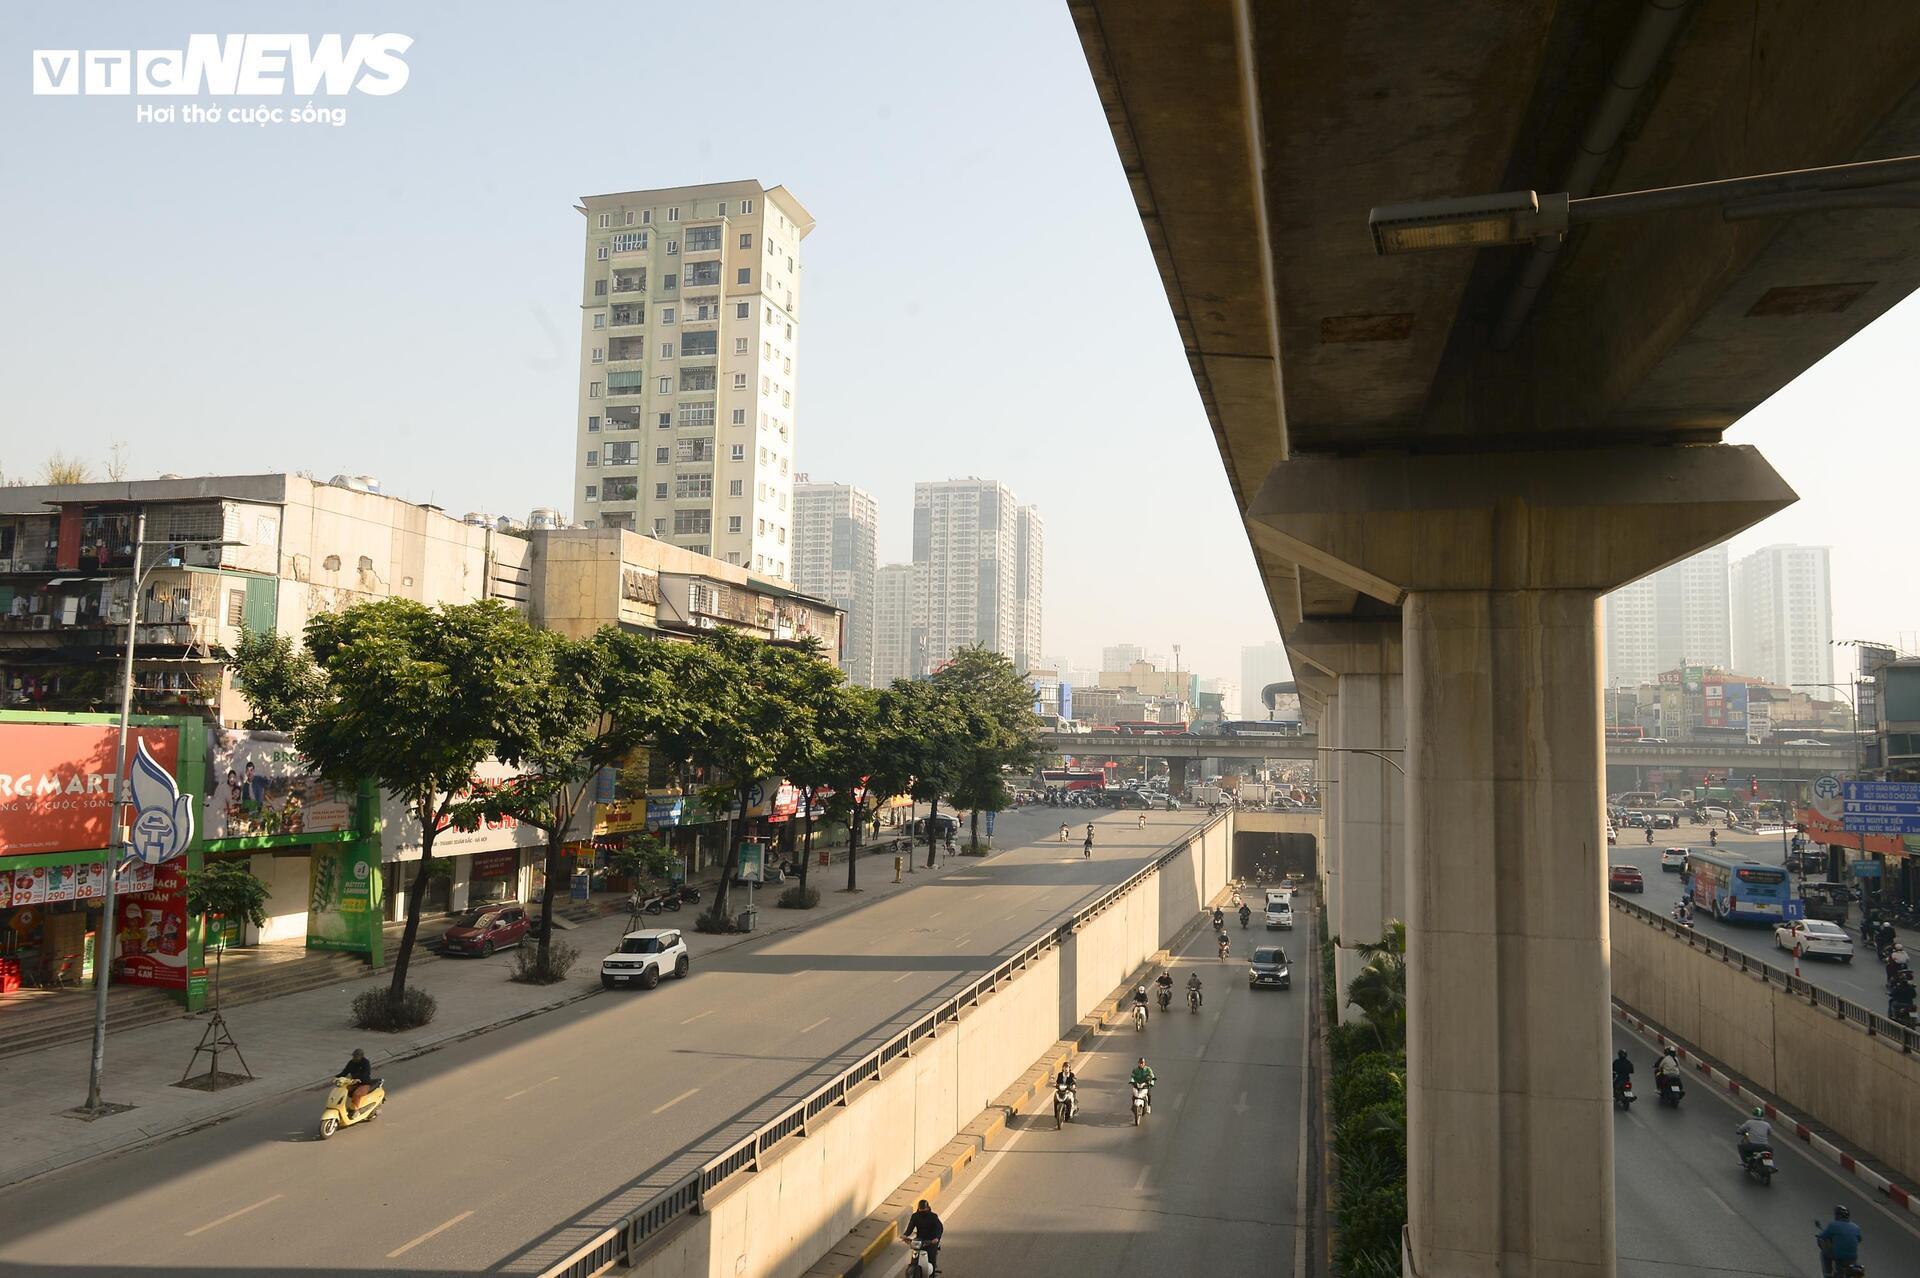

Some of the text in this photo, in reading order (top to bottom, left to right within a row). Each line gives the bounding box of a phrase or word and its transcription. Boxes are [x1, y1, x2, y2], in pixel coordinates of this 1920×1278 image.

[77, 885, 93, 897] 68
[132, 882, 147, 891] 109
[15, 892, 32, 904] 99
[48, 891, 65, 901] 290
